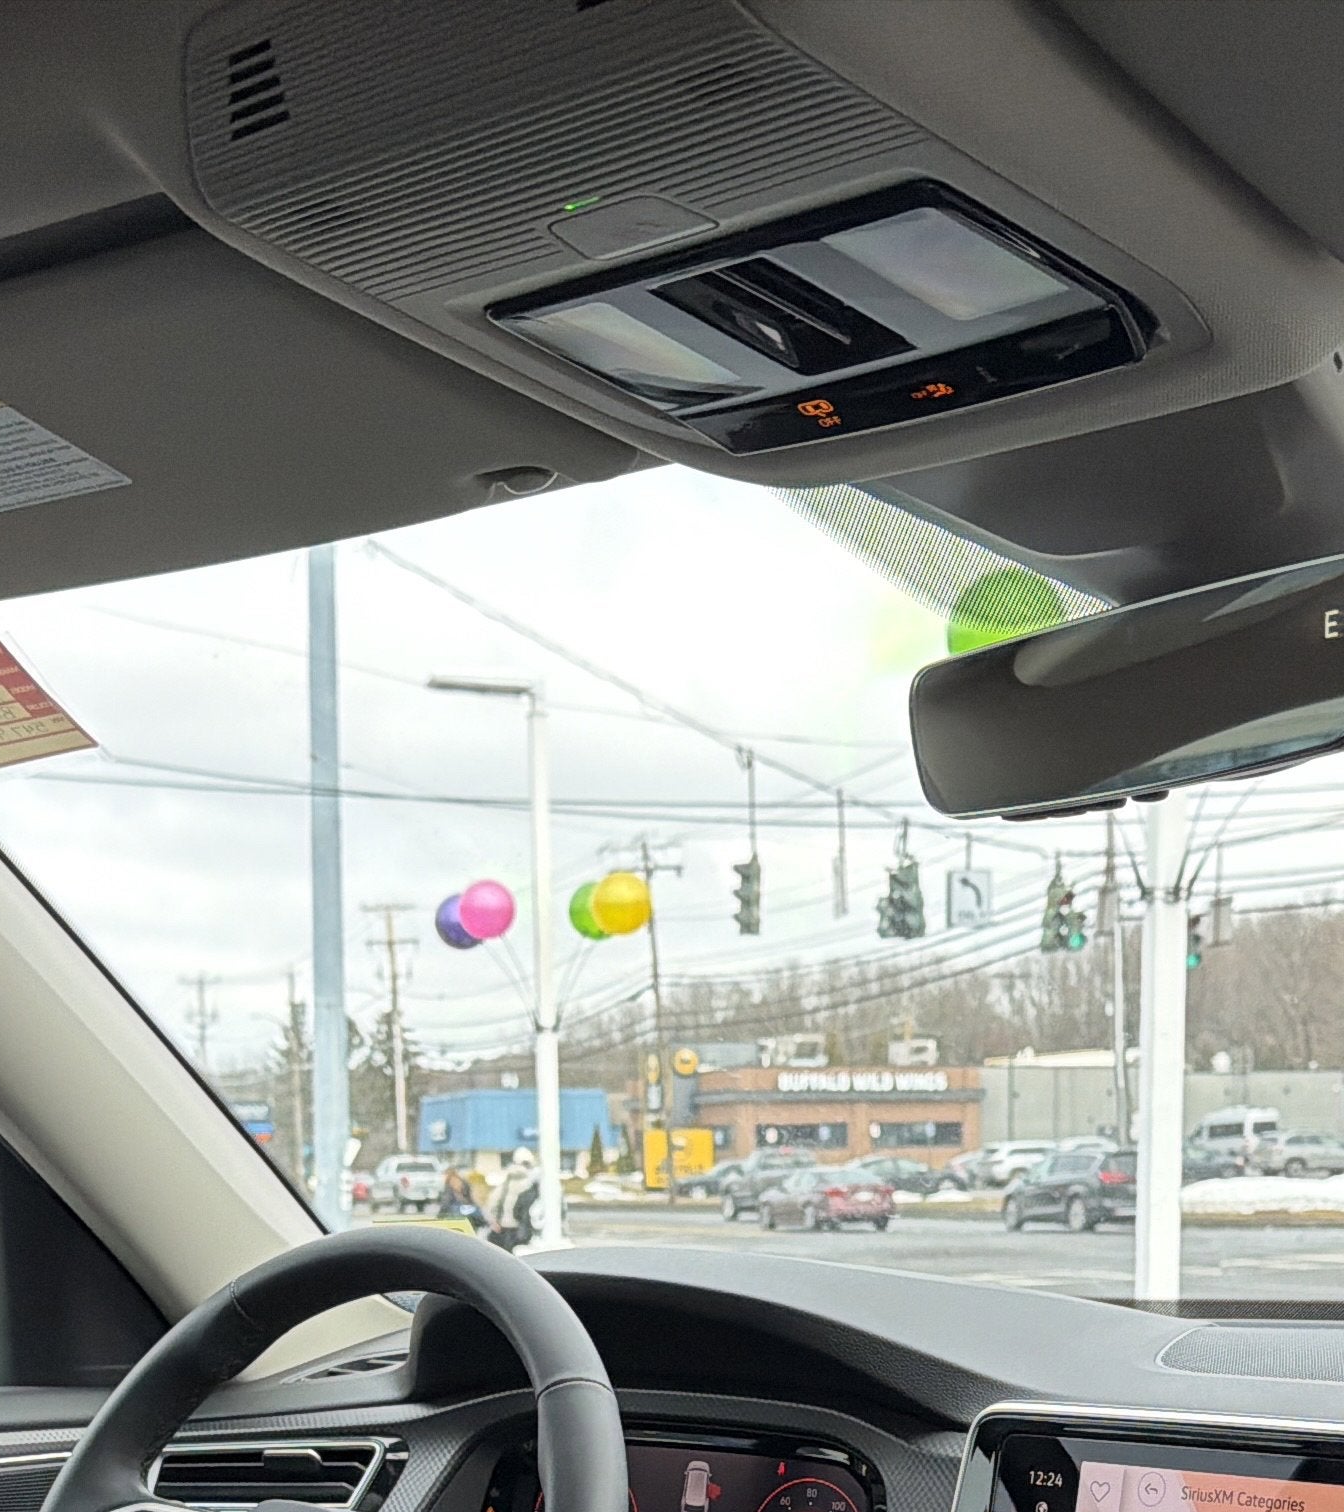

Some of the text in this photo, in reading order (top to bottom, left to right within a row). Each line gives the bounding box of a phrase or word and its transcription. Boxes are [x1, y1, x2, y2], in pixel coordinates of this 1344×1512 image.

[1324, 609, 1340, 639] E
[1029, 1470, 1063, 1488] 12:24
[806, 1487, 818, 1498] 80
[1180, 1486, 1305, 1512] SiriusXM Categories
[779, 1496, 791, 1506] 60
[831, 1501, 846, 1512] 100
